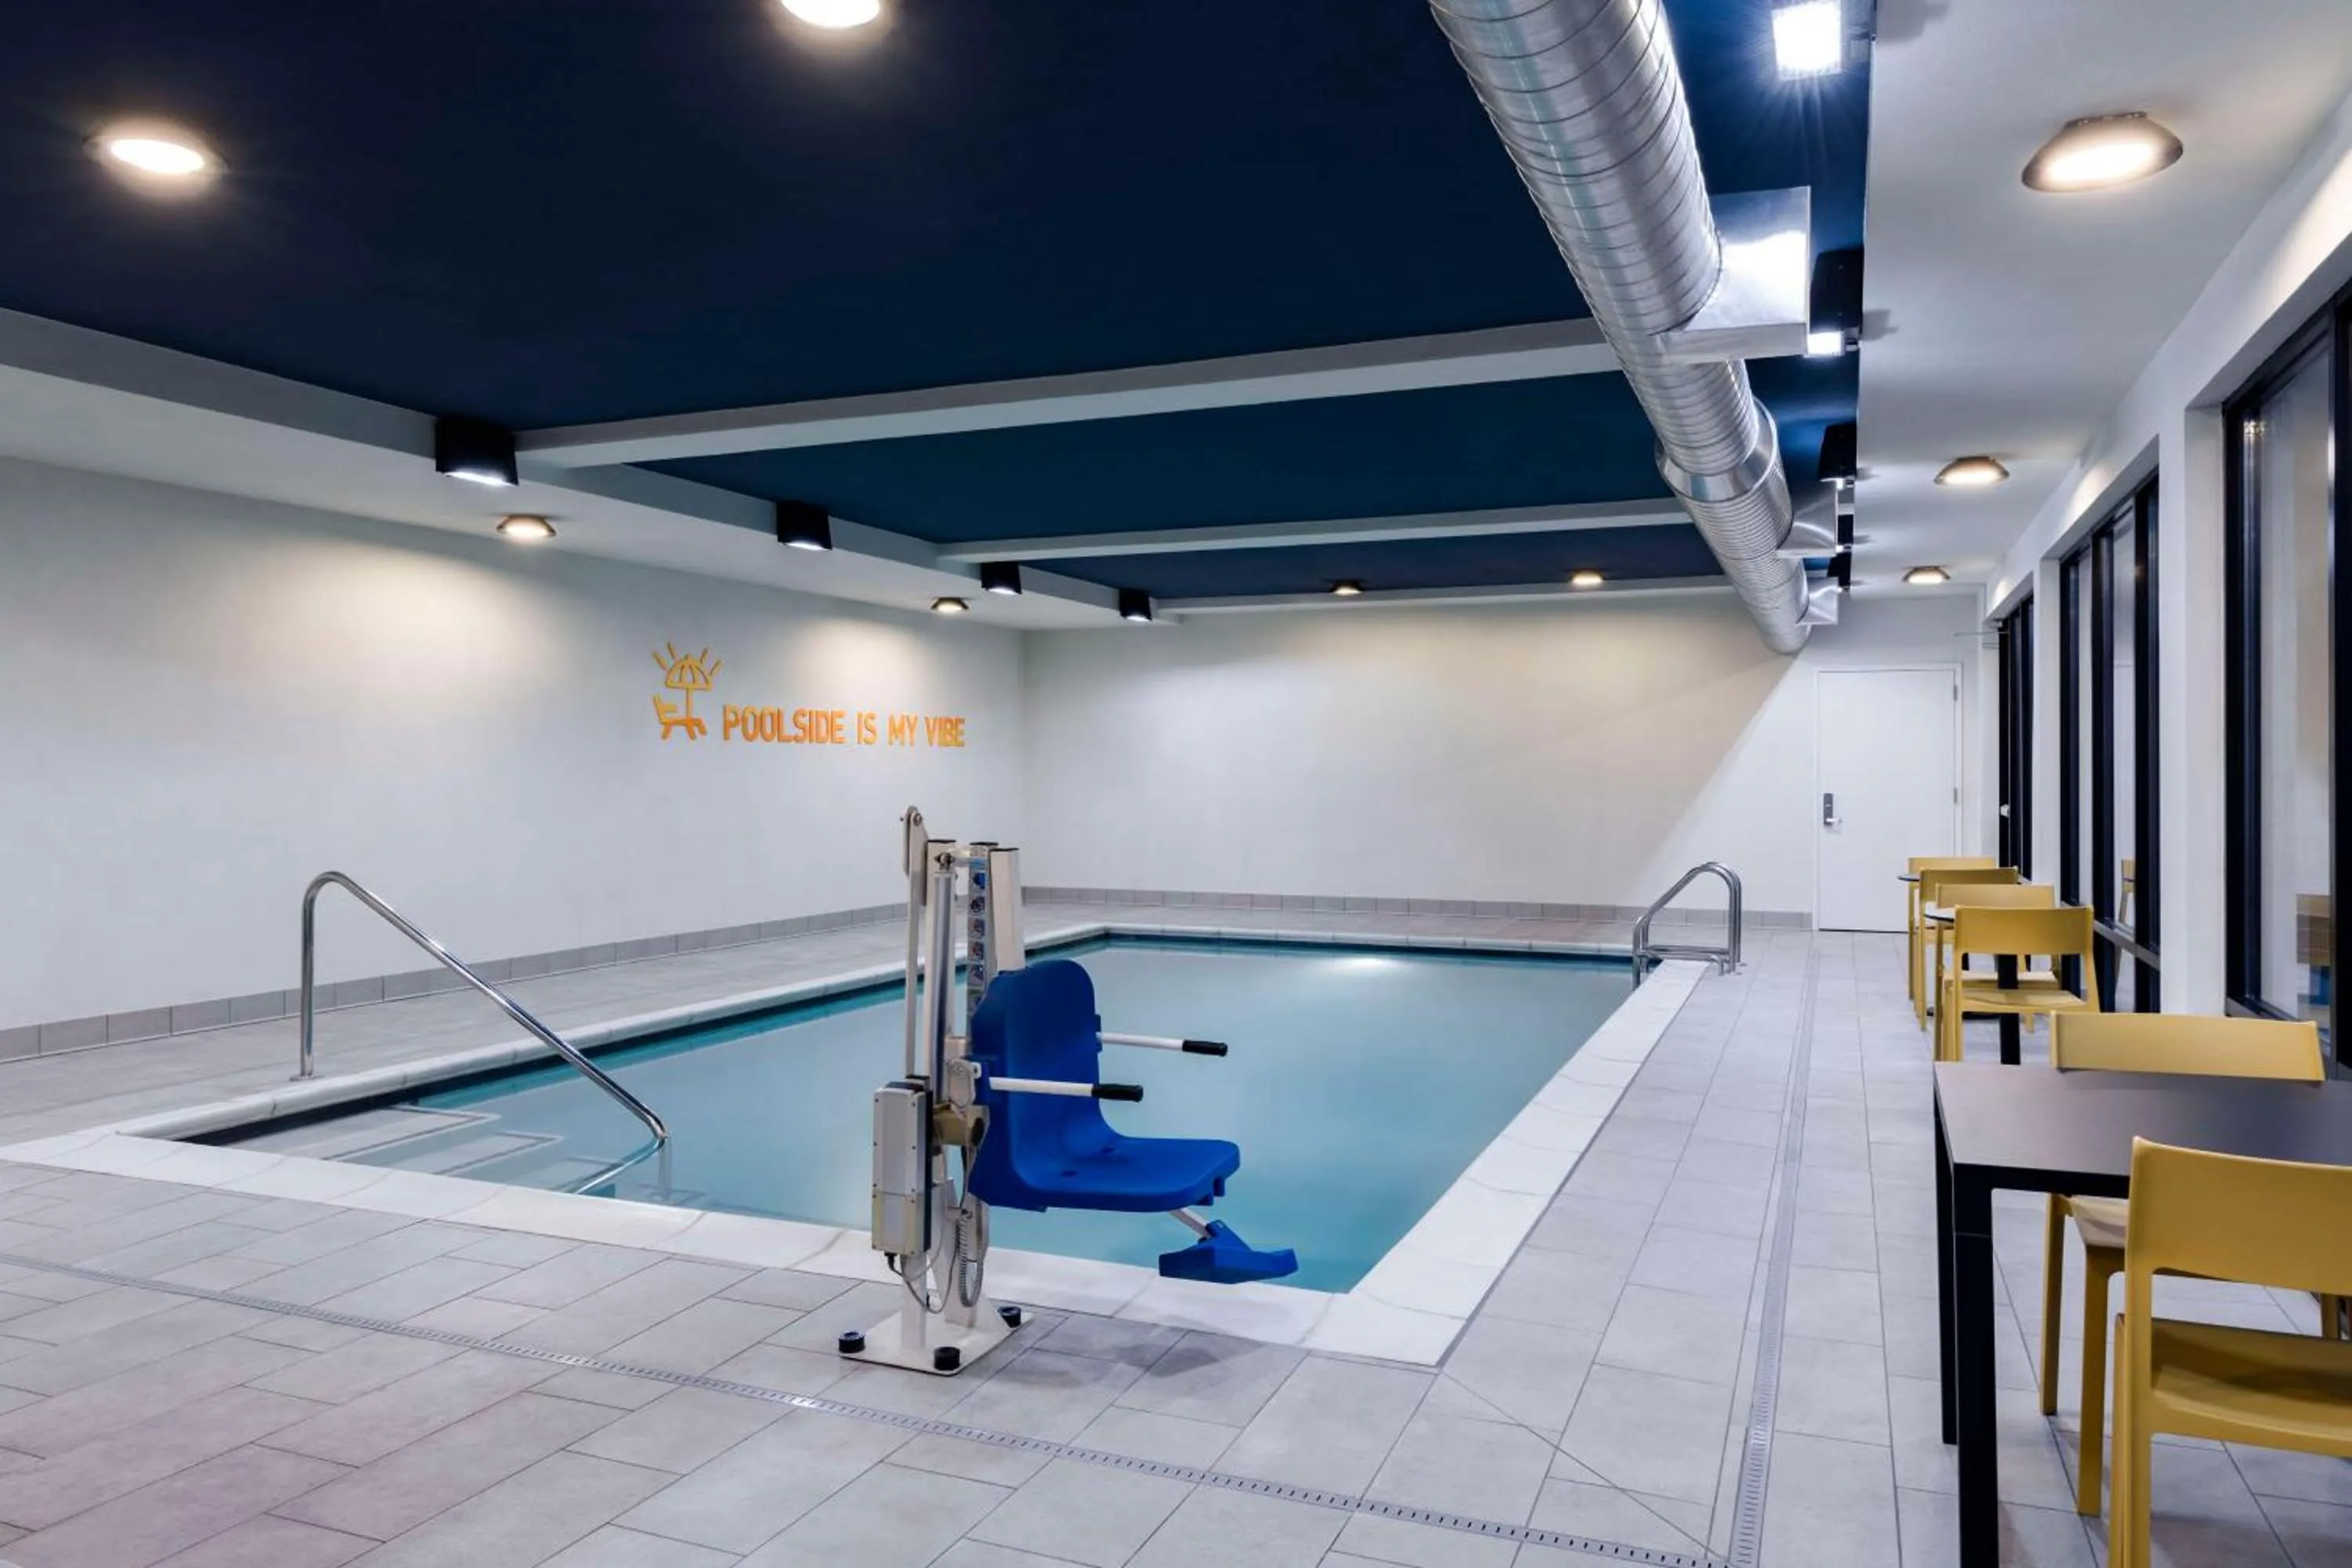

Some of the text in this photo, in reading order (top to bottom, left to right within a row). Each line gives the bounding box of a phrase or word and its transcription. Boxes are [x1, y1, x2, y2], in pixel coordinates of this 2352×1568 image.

[723, 704, 965, 748] POOLSIDE IS MY VIBE
